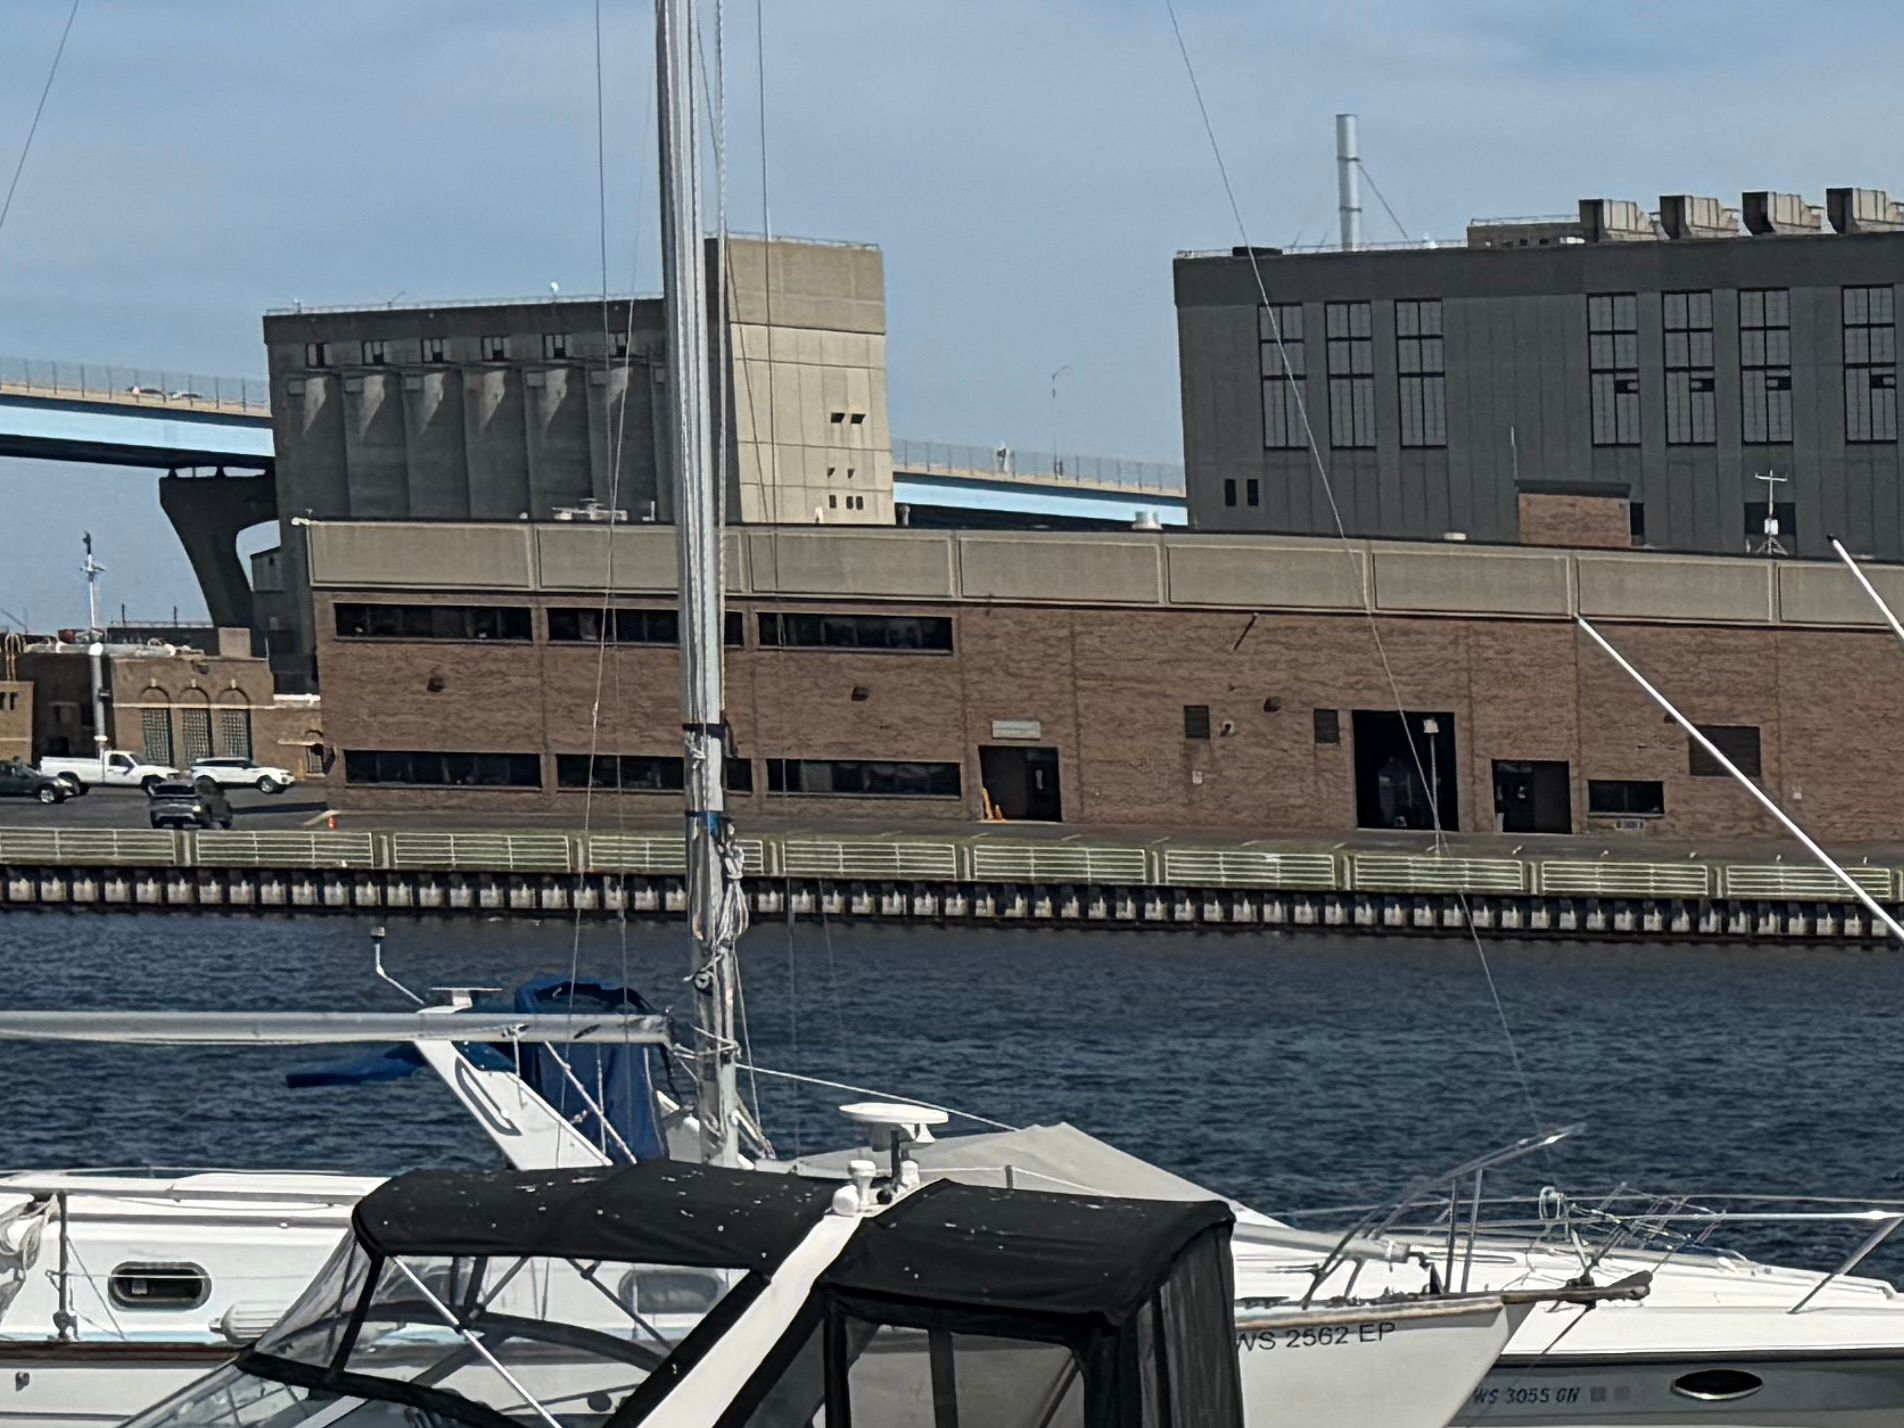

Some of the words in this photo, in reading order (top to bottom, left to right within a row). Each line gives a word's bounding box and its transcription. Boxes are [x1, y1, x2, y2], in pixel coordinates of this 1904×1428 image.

[1236, 1330, 1276, 1352] WS
[1285, 1326, 1349, 1349] 2562
[1359, 1321, 1396, 1343] EP
[1506, 1386, 1551, 1404] 3055
